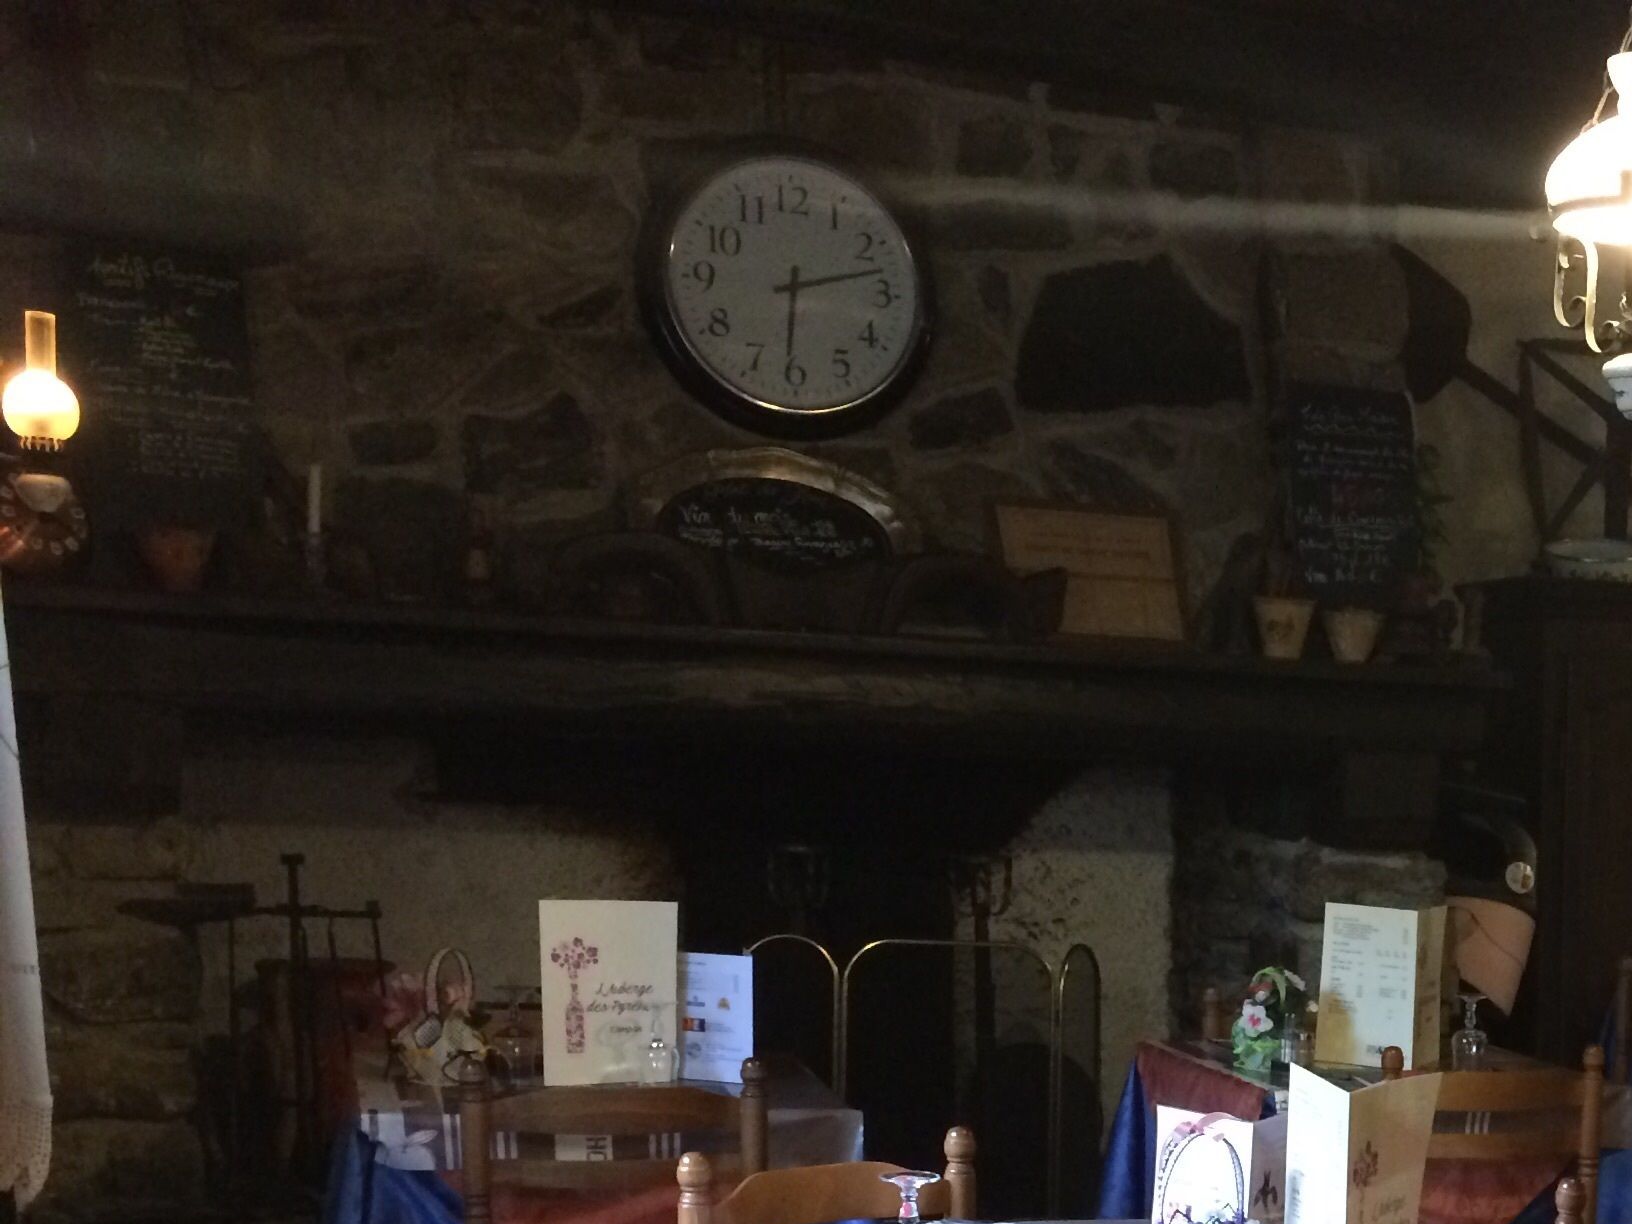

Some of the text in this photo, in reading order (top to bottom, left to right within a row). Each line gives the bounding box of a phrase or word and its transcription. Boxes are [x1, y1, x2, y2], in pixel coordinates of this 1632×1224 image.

[738, 194, 765, 225] 11
[776, 183, 809, 216] 12
[830, 203, 839, 230] 1
[707, 224, 742, 256] 10
[855, 232, 875, 262] 2
[693, 259, 716, 292] 9
[873, 279, 894, 309] 3
[707, 308, 730, 337] 8
[858, 319, 879, 349] 4
[746, 342, 765, 372] 7
[784, 355, 807, 387] 6
[832, 348, 851, 378] 5
